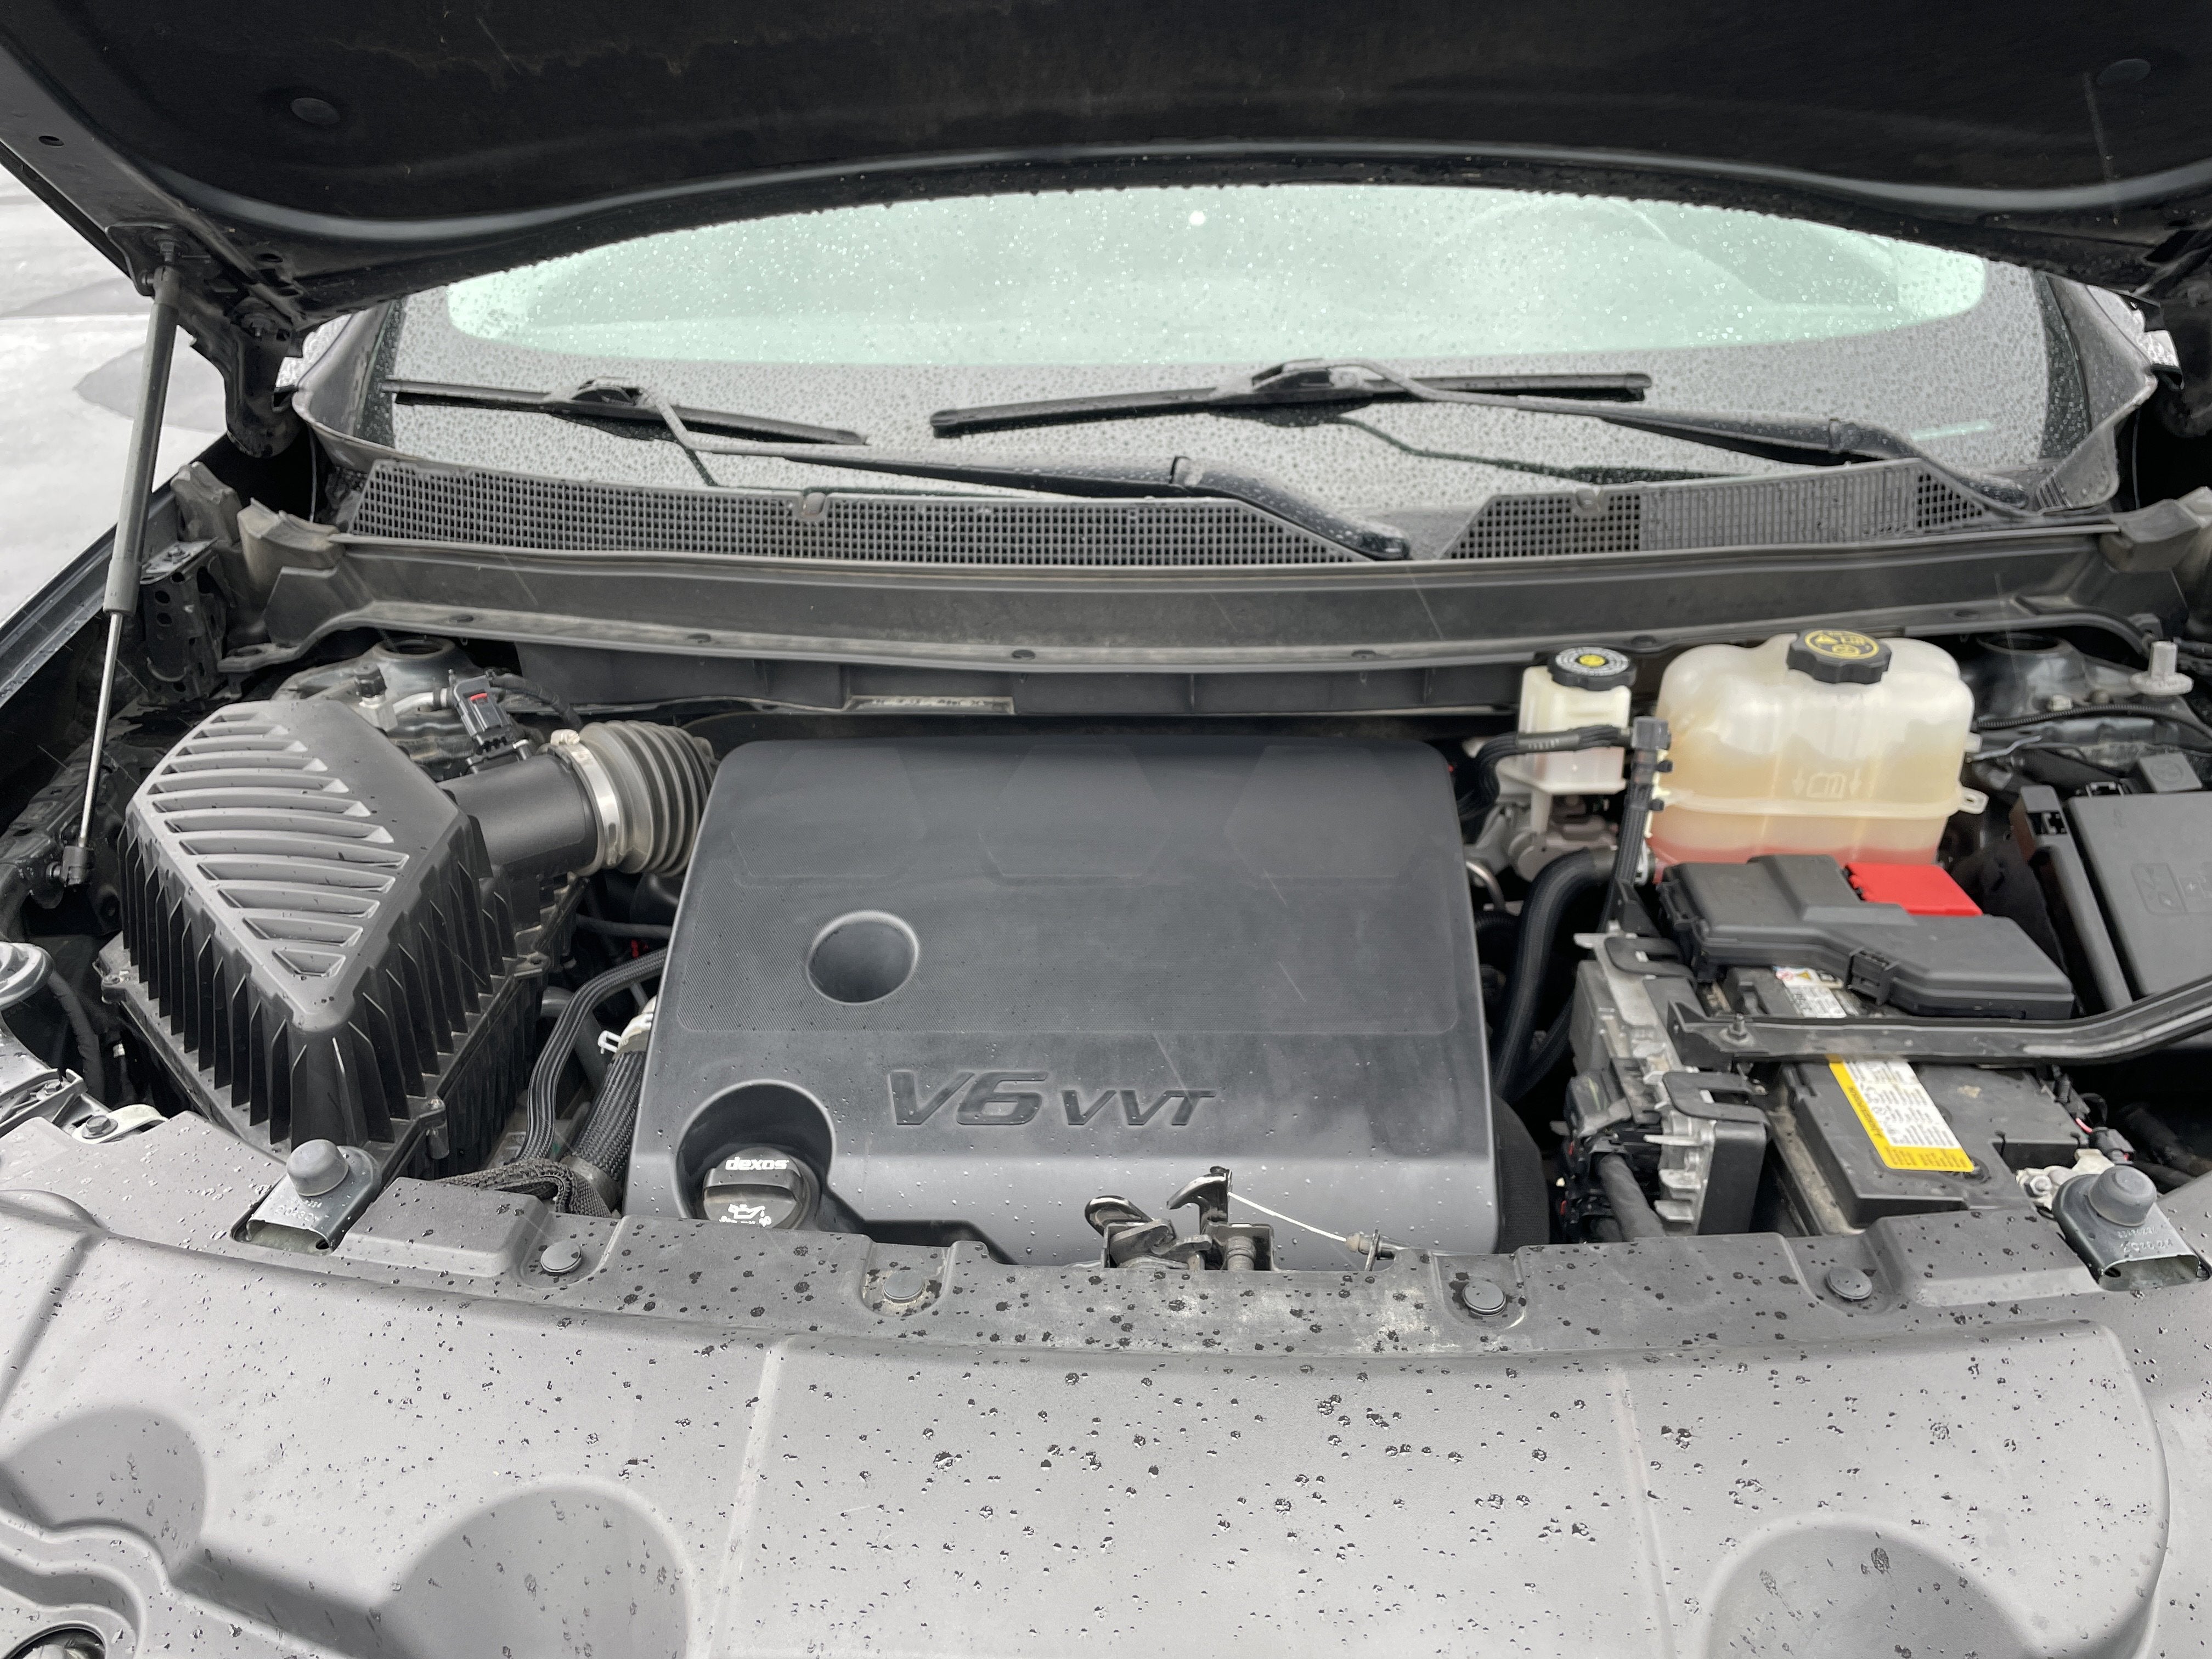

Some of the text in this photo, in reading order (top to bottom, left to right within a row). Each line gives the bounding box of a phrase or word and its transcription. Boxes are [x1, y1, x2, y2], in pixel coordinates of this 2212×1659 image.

[888, 1070, 1216, 1126] V6 VVT
[725, 1156, 788, 1170] dexos
